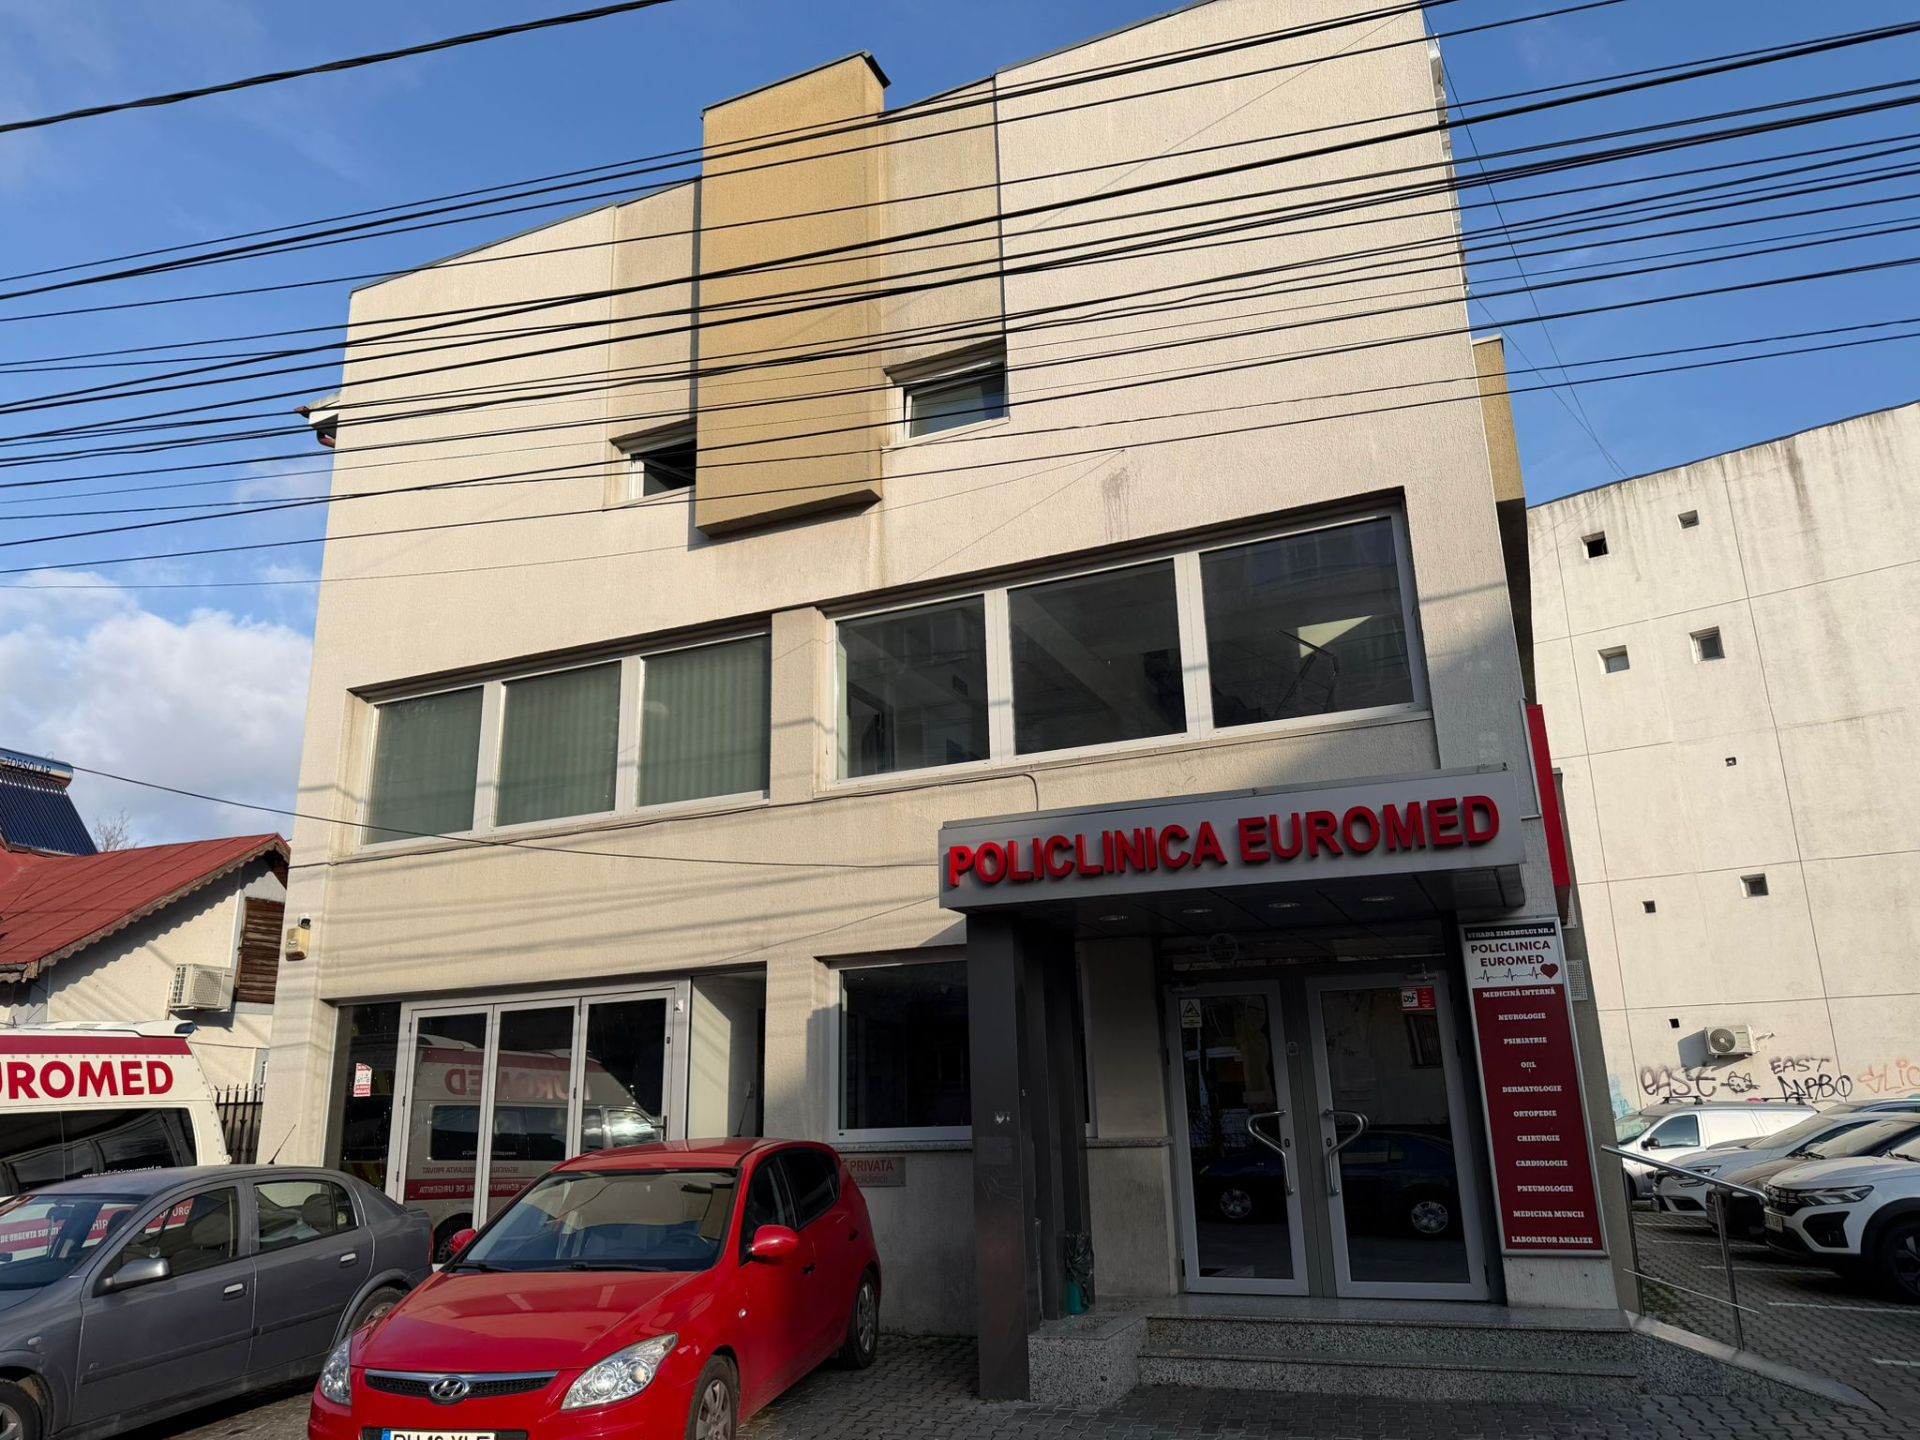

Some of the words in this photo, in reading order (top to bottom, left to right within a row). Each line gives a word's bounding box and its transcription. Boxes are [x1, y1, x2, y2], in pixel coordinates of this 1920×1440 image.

[6, 756, 52, 774] TOPSOLAR
[948, 820, 1228, 888] POLICLINICA
[1238, 794, 1500, 863] EUROMED
[1467, 930, 1495, 939] STRADA
[1470, 940, 1551, 954] POLICLINICA
[1480, 954, 1545, 967] EUROMED
[1498, 1012, 1546, 1021] NEUROLOGIE
[1503, 1037, 1548, 1045] PSIHIATRIE
[0, 1060, 174, 1100] ROMED
[1502, 1085, 1562, 1093] DERMATOLOGIE
[1517, 1134, 1560, 1142] CHIRURGIE
[1515, 1159, 1568, 1167] CARDIOLOGIE
[1517, 1185, 1574, 1193] PNEUMOLOGIE
[1513, 1210, 1553, 1218] MEDICINA
[1554, 1210, 1584, 1218] MUNCII
[1558, 1236, 1593, 1244] ANALIZE
